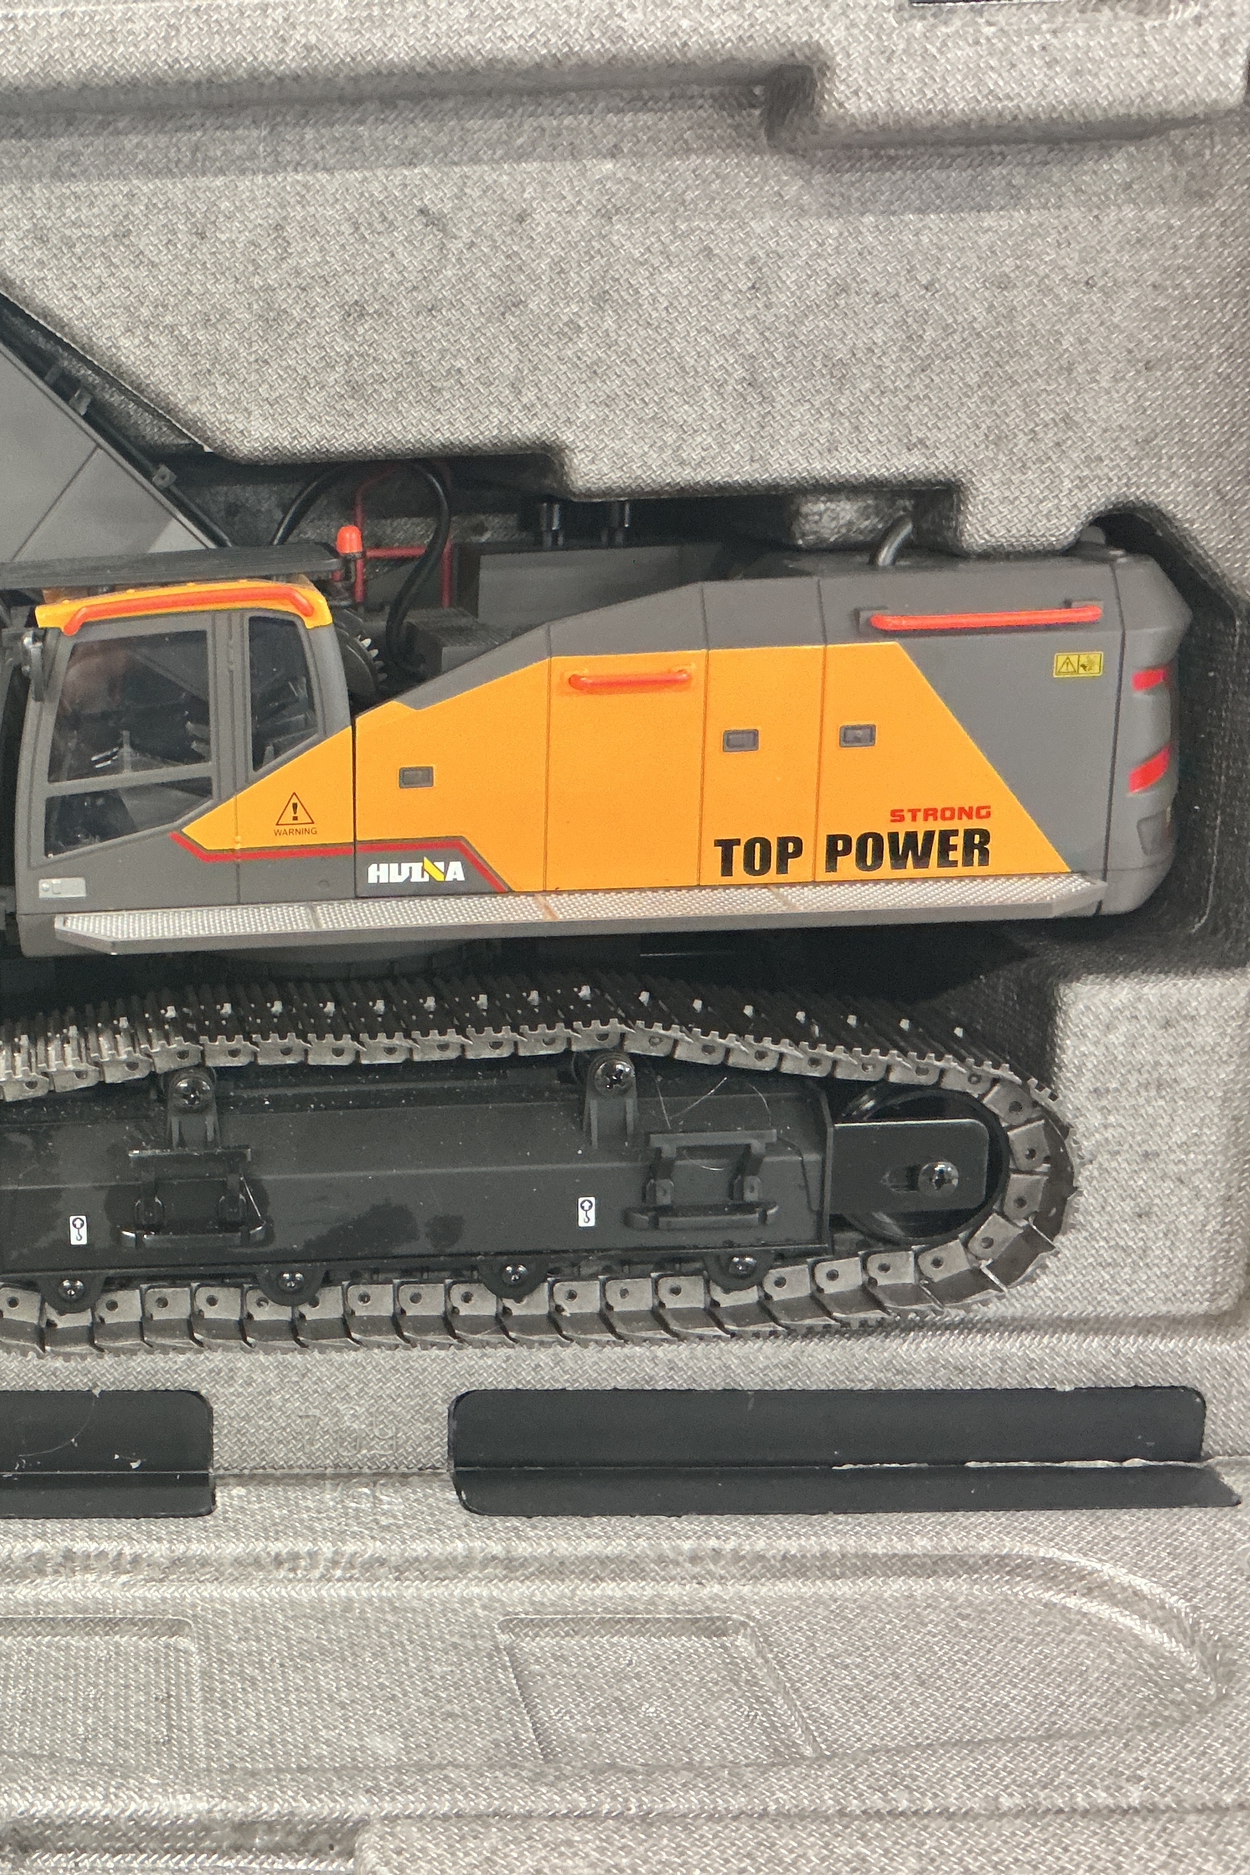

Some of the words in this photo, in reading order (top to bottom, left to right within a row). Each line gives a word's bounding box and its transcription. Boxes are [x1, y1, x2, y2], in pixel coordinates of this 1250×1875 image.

[889, 805, 992, 823] STRONG
[273, 827, 318, 837] WARNING
[713, 836, 803, 877] TOP
[824, 828, 992, 873] POWER
[367, 856, 465, 884] HUINA
